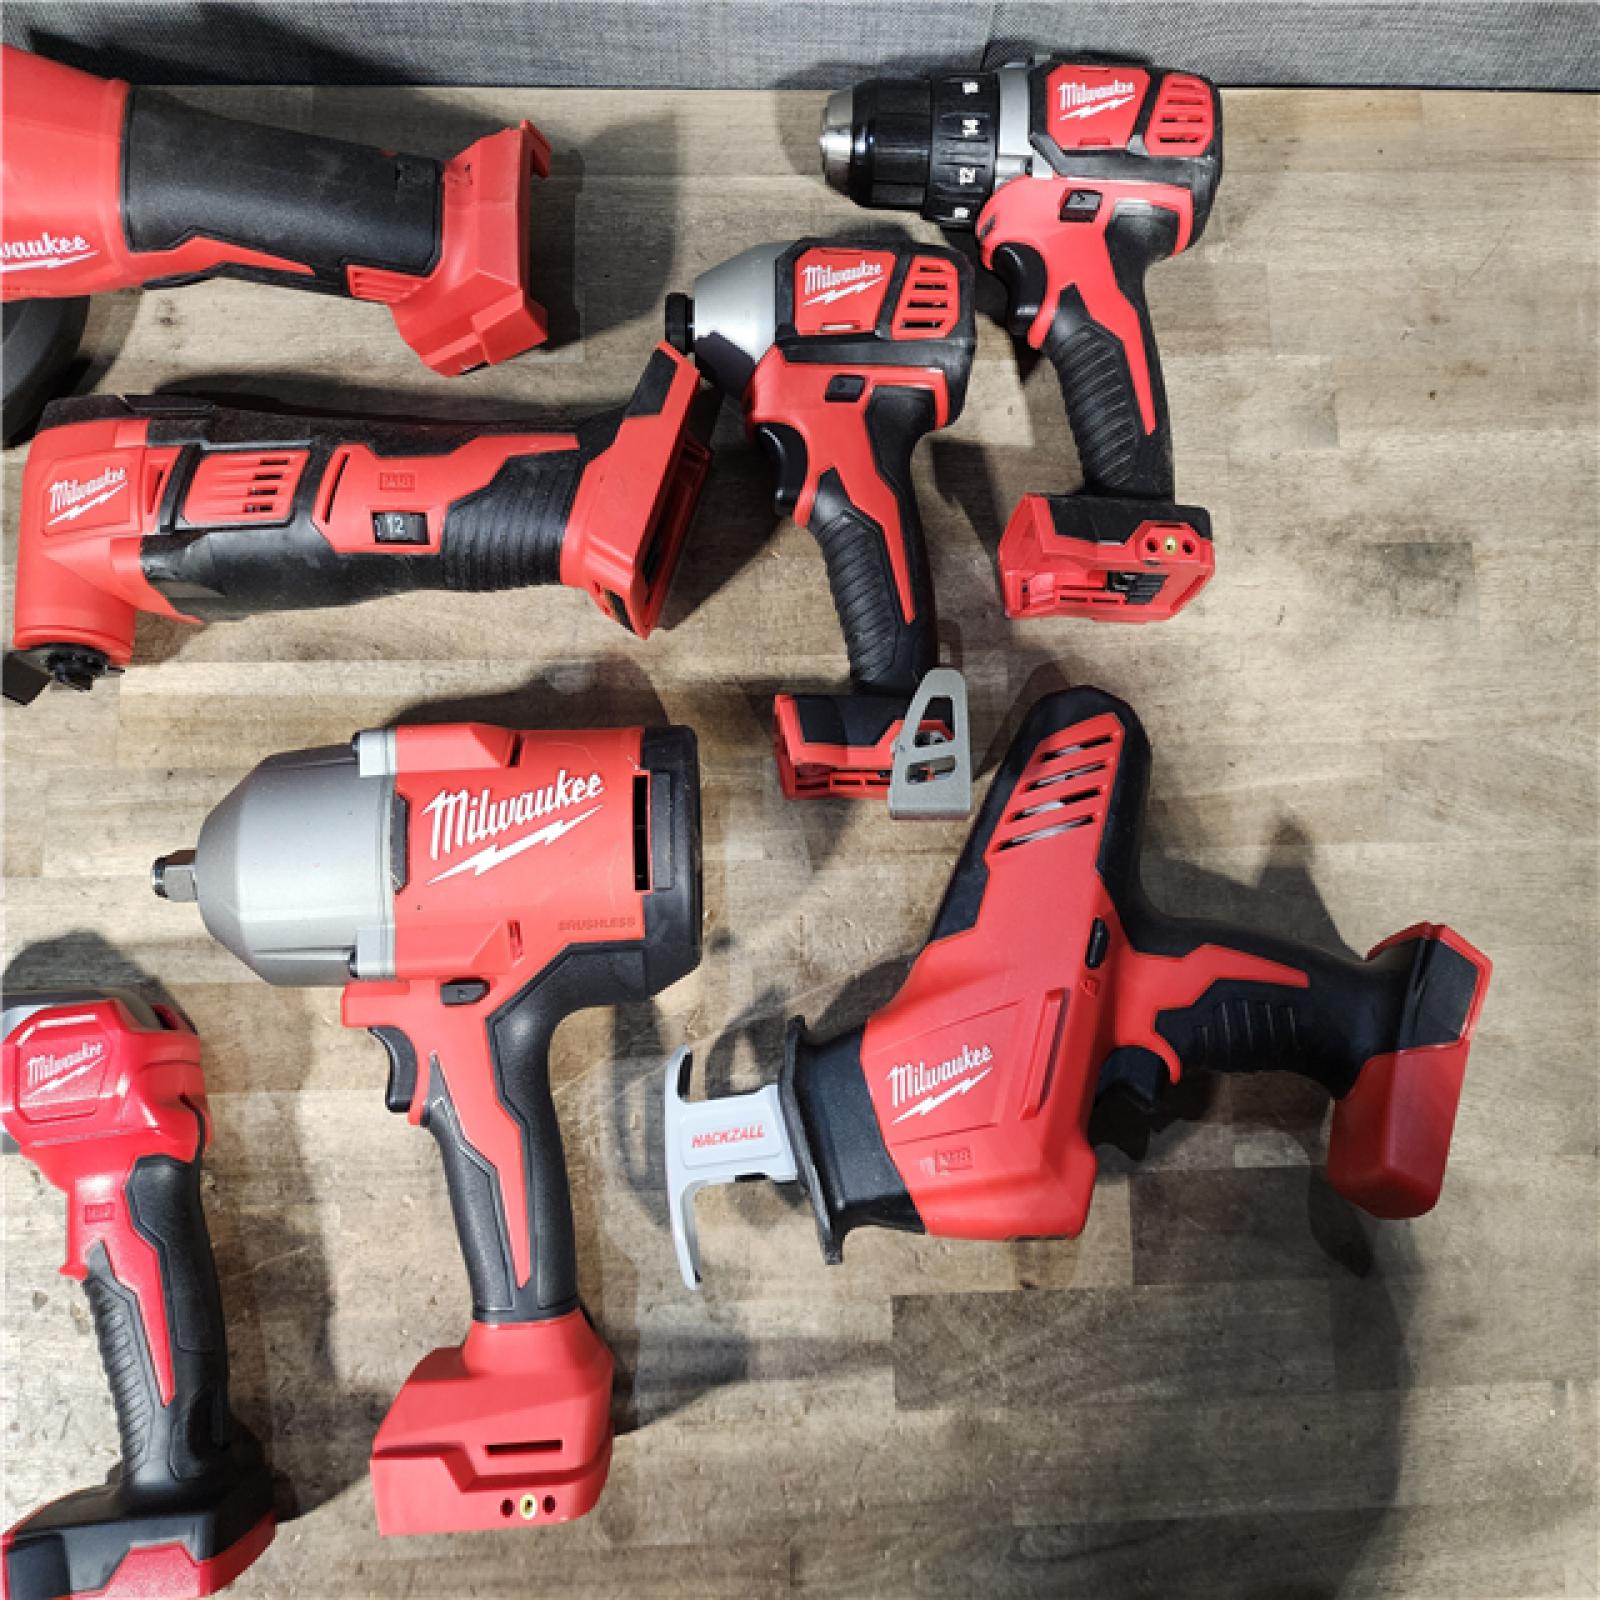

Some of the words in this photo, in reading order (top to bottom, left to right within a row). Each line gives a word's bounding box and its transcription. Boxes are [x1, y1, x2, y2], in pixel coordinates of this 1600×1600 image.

[1058, 79, 1135, 111] Milwaukee
[801, 259, 882, 295] Milwaukee
[48, 465, 126, 514] Milwaukee
[421, 769, 604, 861] Milwaukee
[27, 1041, 104, 1089] Milwaukee
[886, 1044, 993, 1108] Milwaukee
[692, 1122, 765, 1149] HACKZALL
